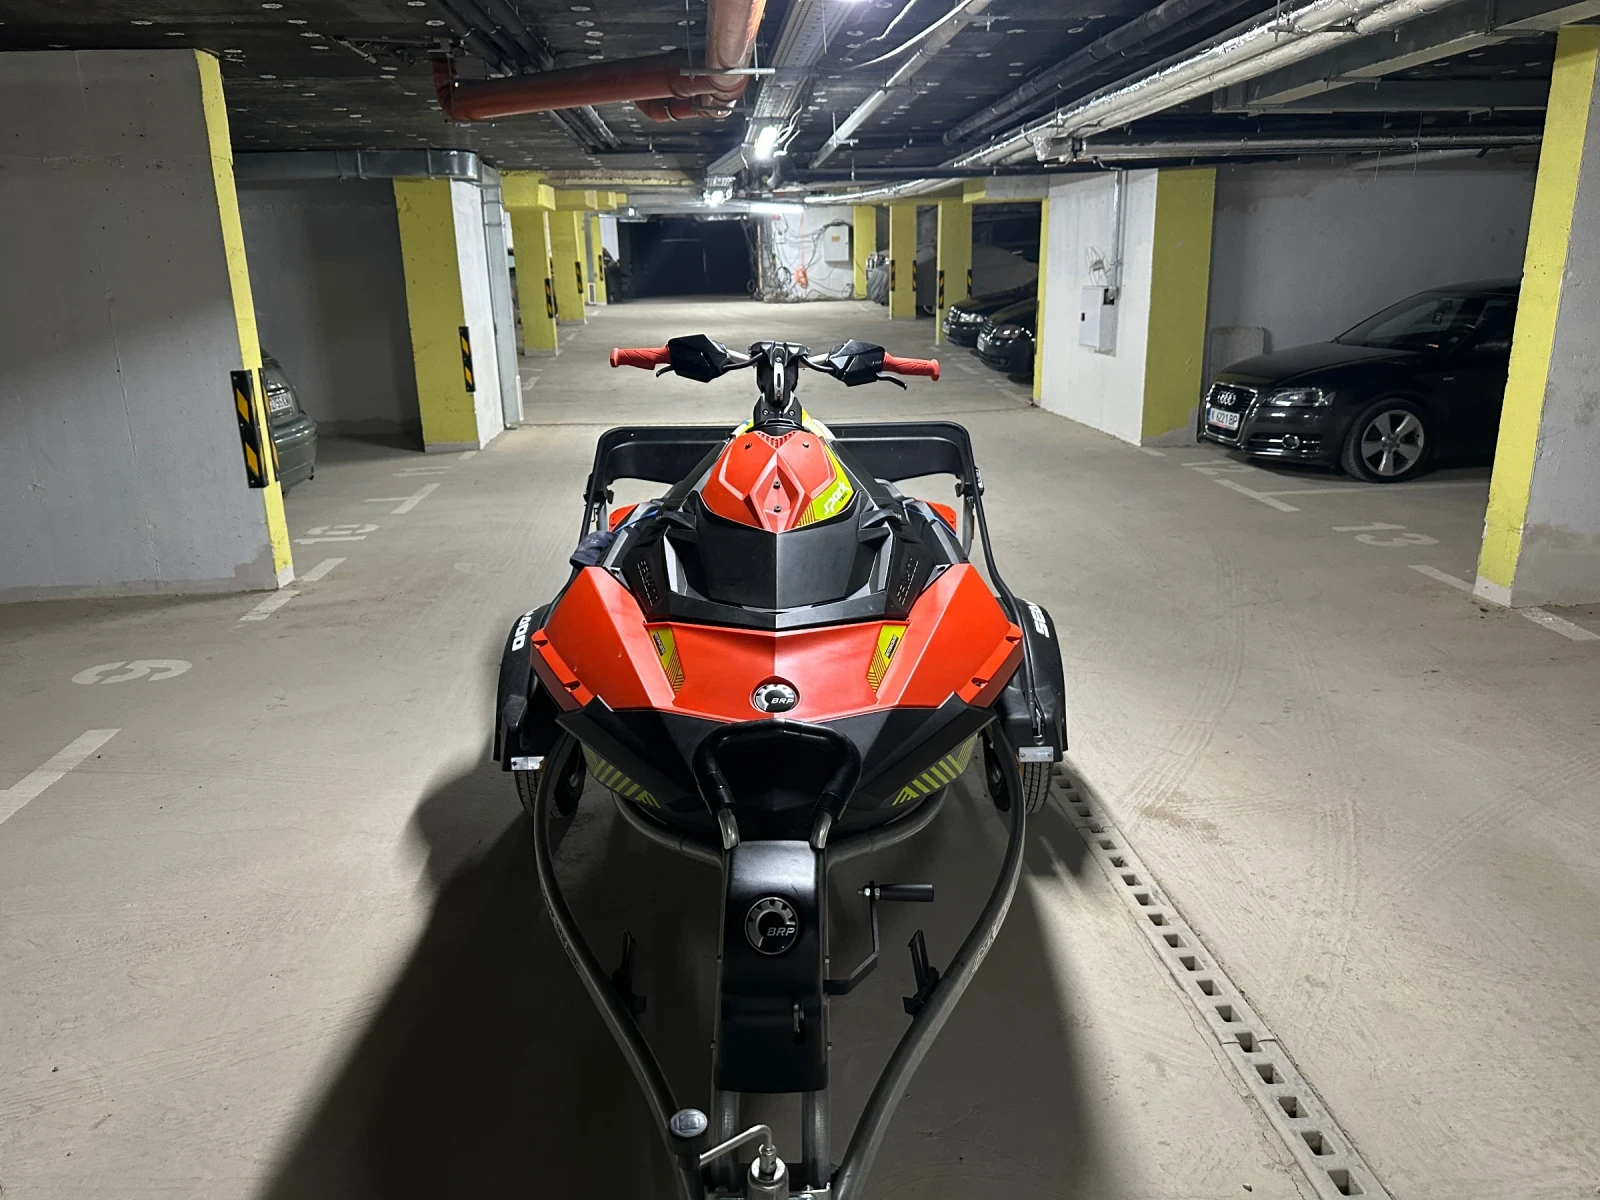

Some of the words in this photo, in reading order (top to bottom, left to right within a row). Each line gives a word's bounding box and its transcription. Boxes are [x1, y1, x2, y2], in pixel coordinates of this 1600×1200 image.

[292, 524, 380, 544] 10
[1331, 521, 1440, 547] 13
[511, 611, 534, 651] DOO
[71, 659, 193, 685] 9
[771, 697, 795, 705] BRP
[766, 927, 796, 937] BRP
